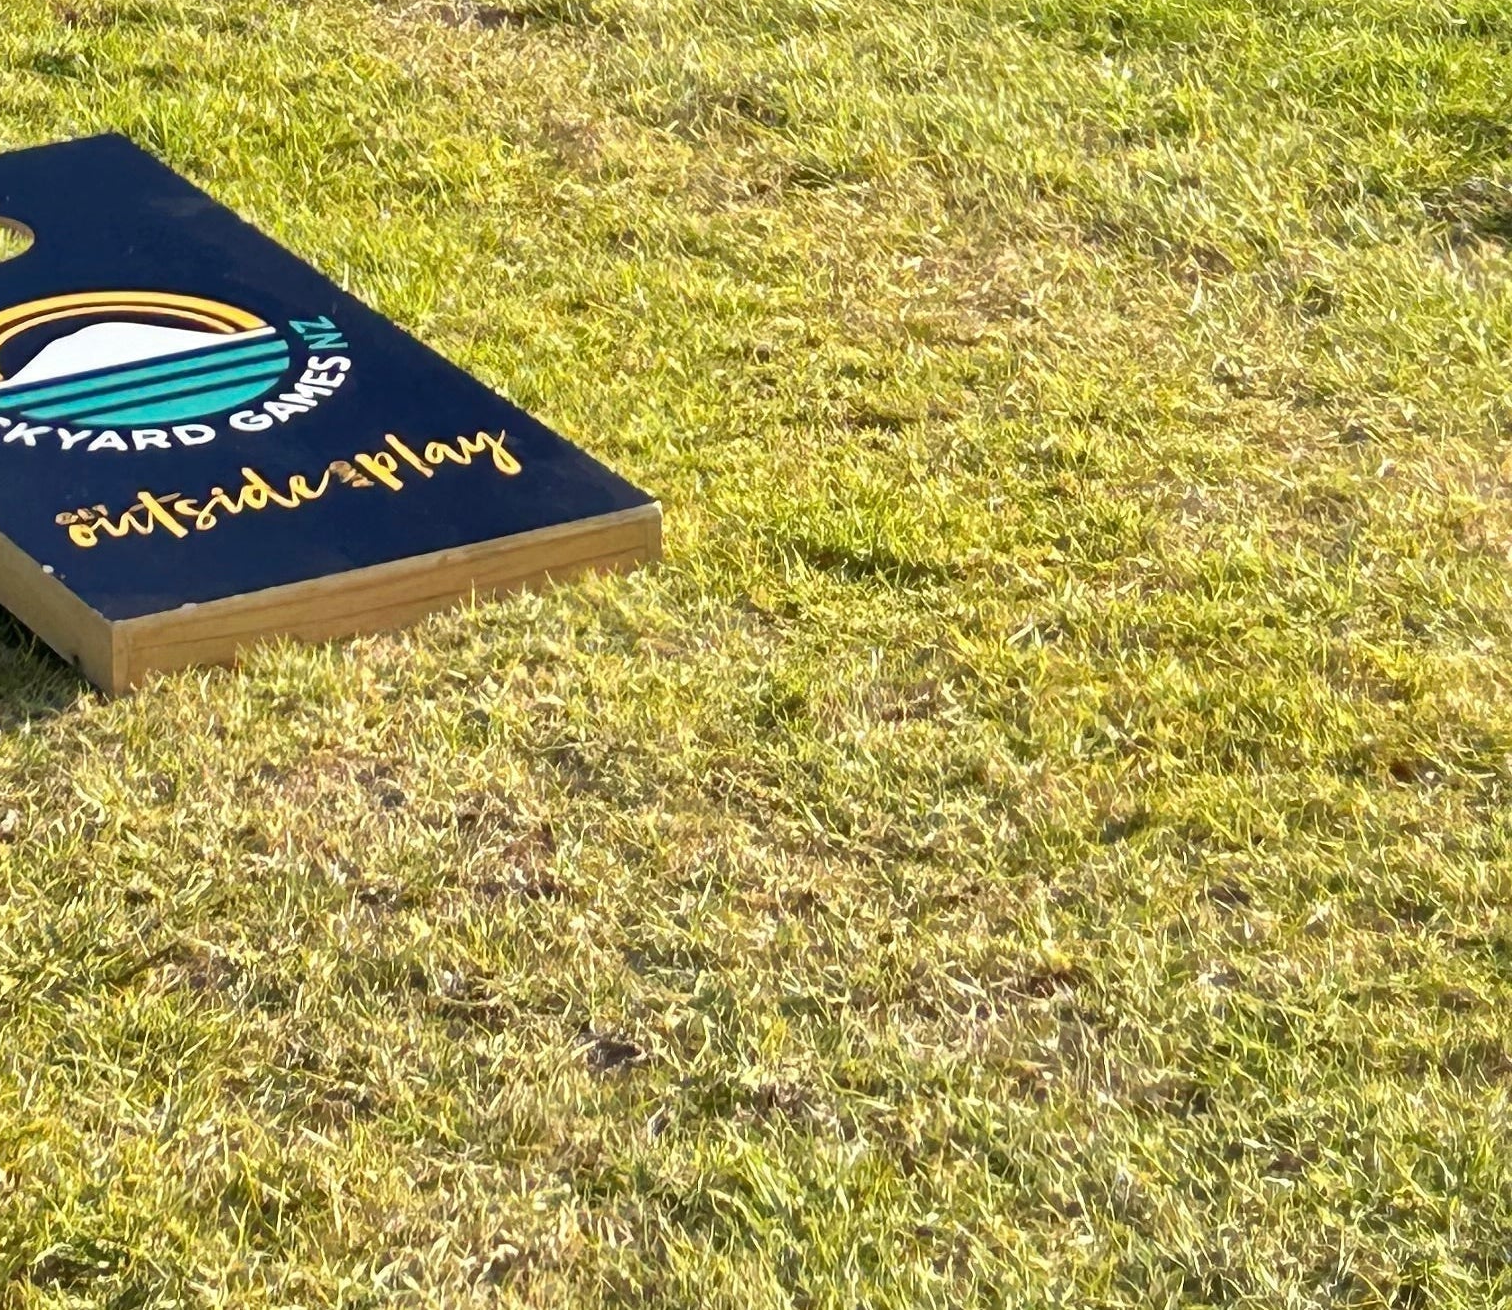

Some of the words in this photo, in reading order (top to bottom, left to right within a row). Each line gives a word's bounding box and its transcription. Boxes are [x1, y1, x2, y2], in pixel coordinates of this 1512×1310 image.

[289, 316, 348, 350] NZ
[229, 356, 351, 431] GAMES
[68, 467, 331, 547] outside
[354, 429, 522, 491] play
